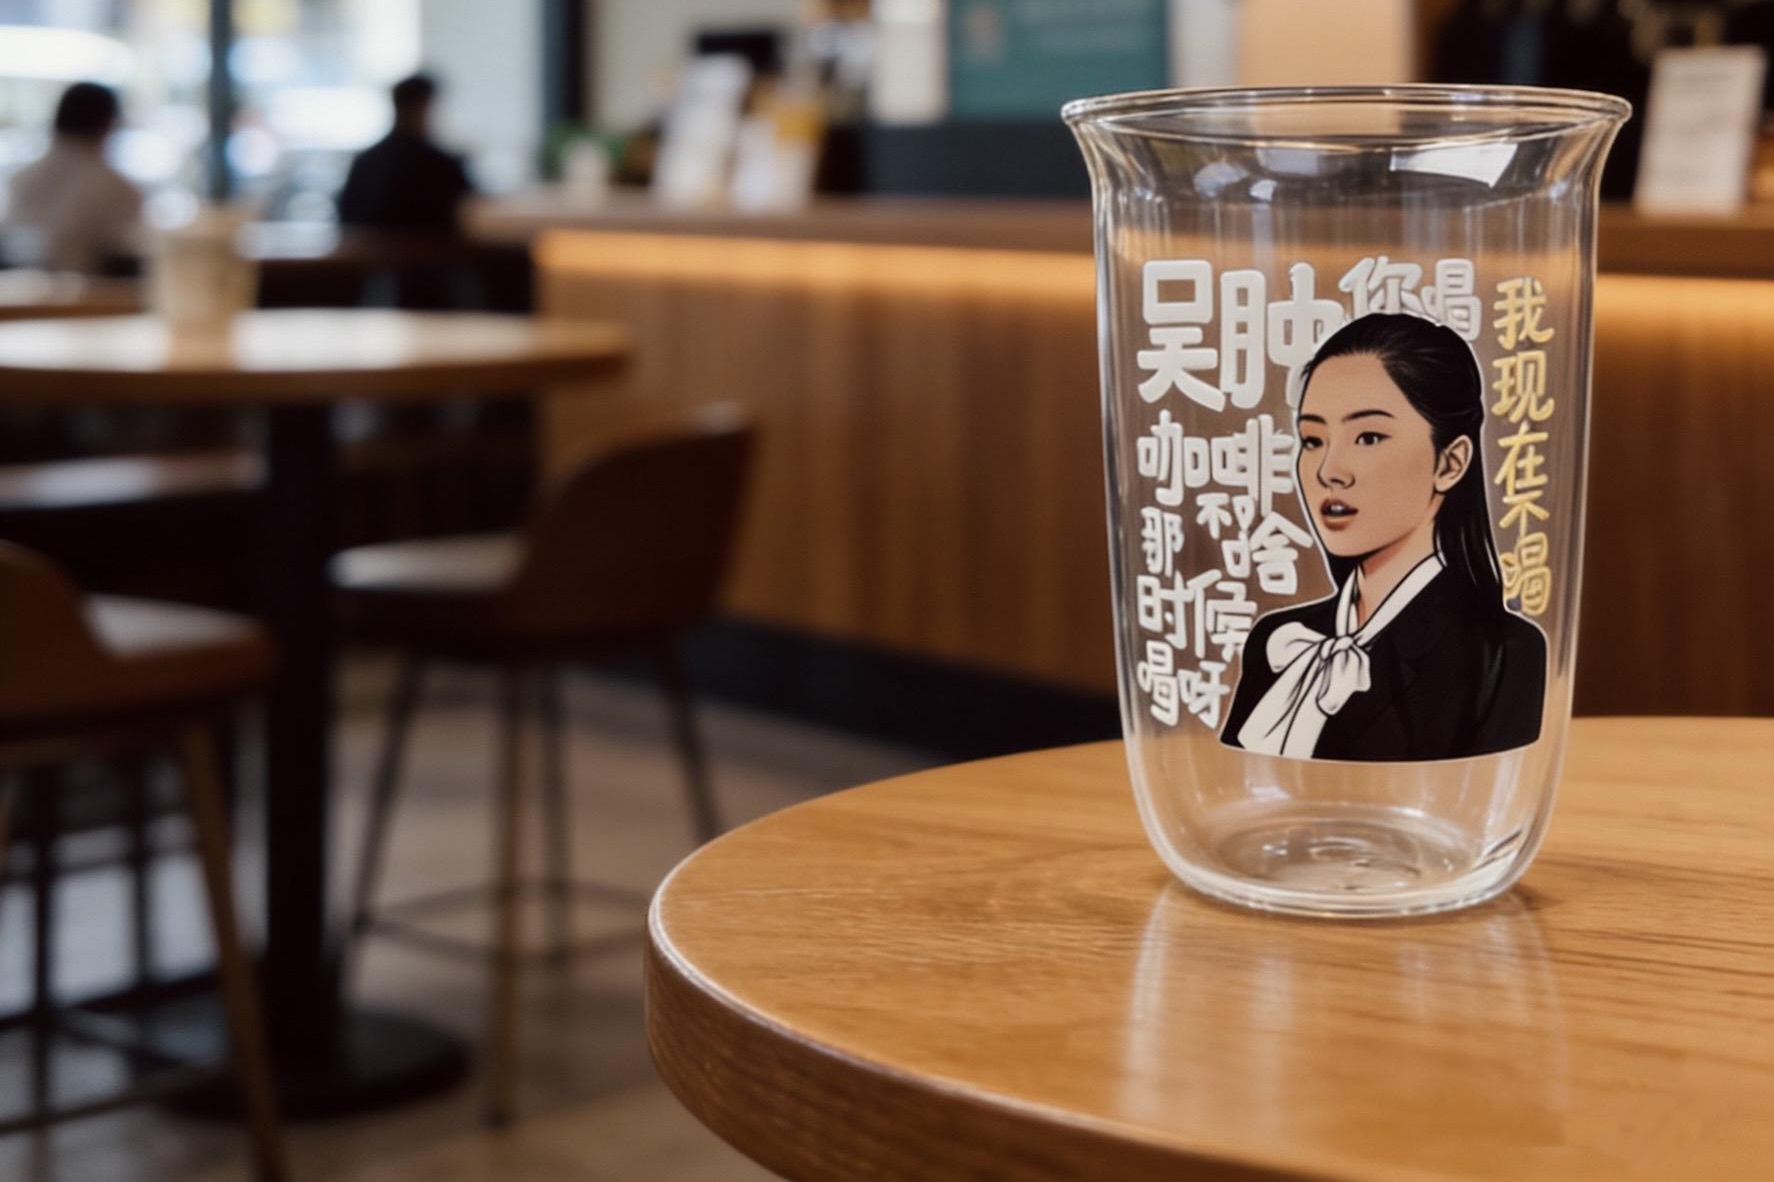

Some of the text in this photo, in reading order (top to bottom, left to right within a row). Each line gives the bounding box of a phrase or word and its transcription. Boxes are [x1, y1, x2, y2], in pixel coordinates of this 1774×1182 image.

[1137, 409, 1294, 517] 咖啡
[1491, 276, 1555, 615] 我现在不喝
